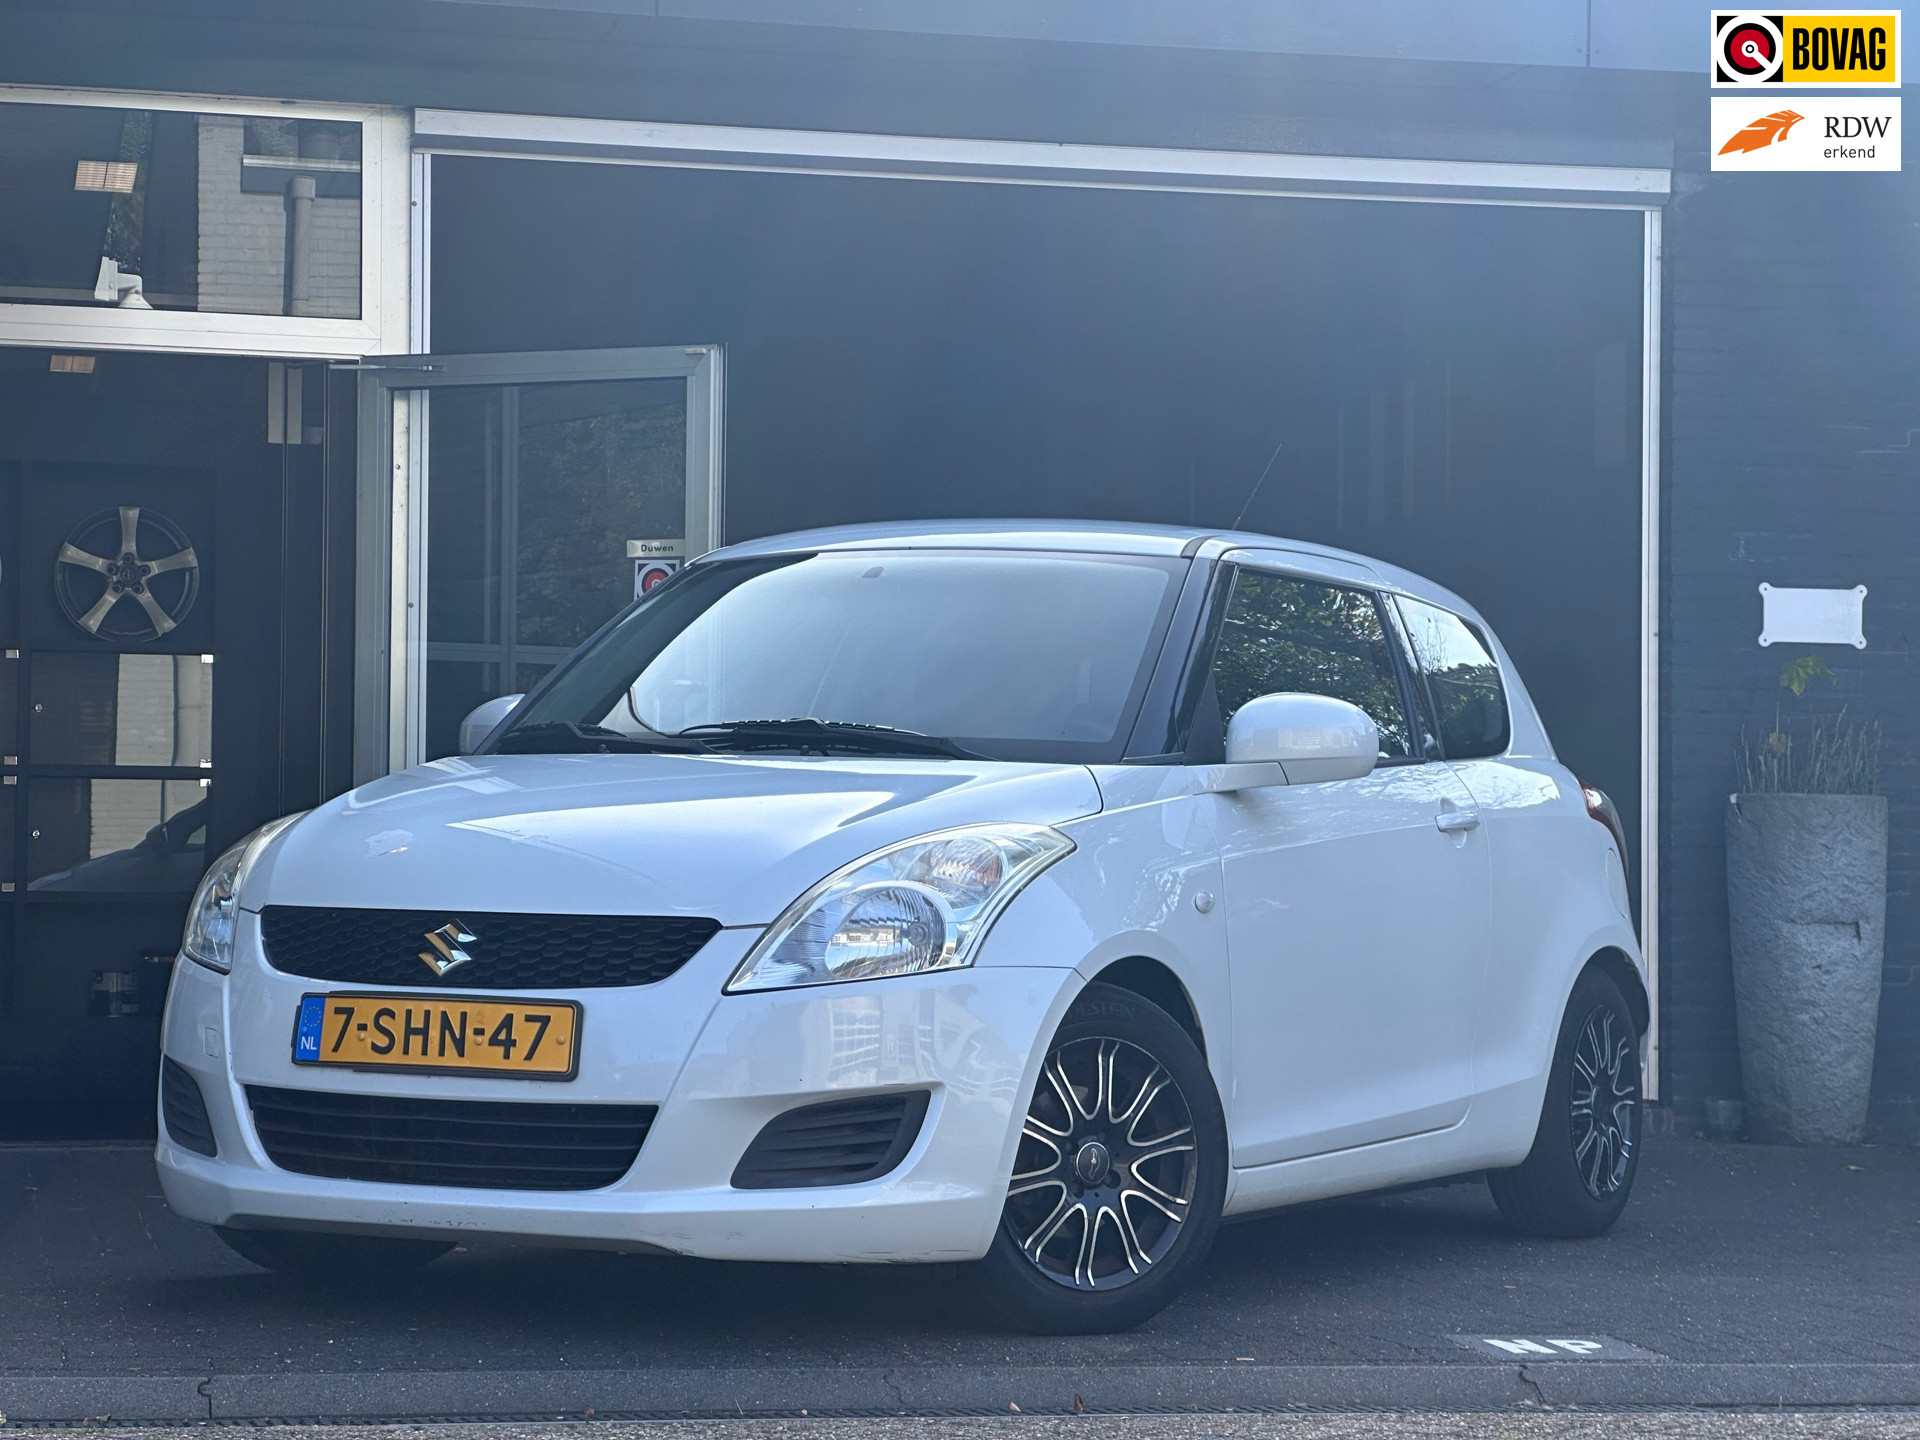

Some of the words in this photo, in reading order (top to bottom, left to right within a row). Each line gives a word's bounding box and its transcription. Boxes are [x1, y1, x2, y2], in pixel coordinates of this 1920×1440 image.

[641, 544, 674, 552] Duwen
[331, 1006, 552, 1061] 7-SHN-47
[300, 1036, 318, 1050] NL
